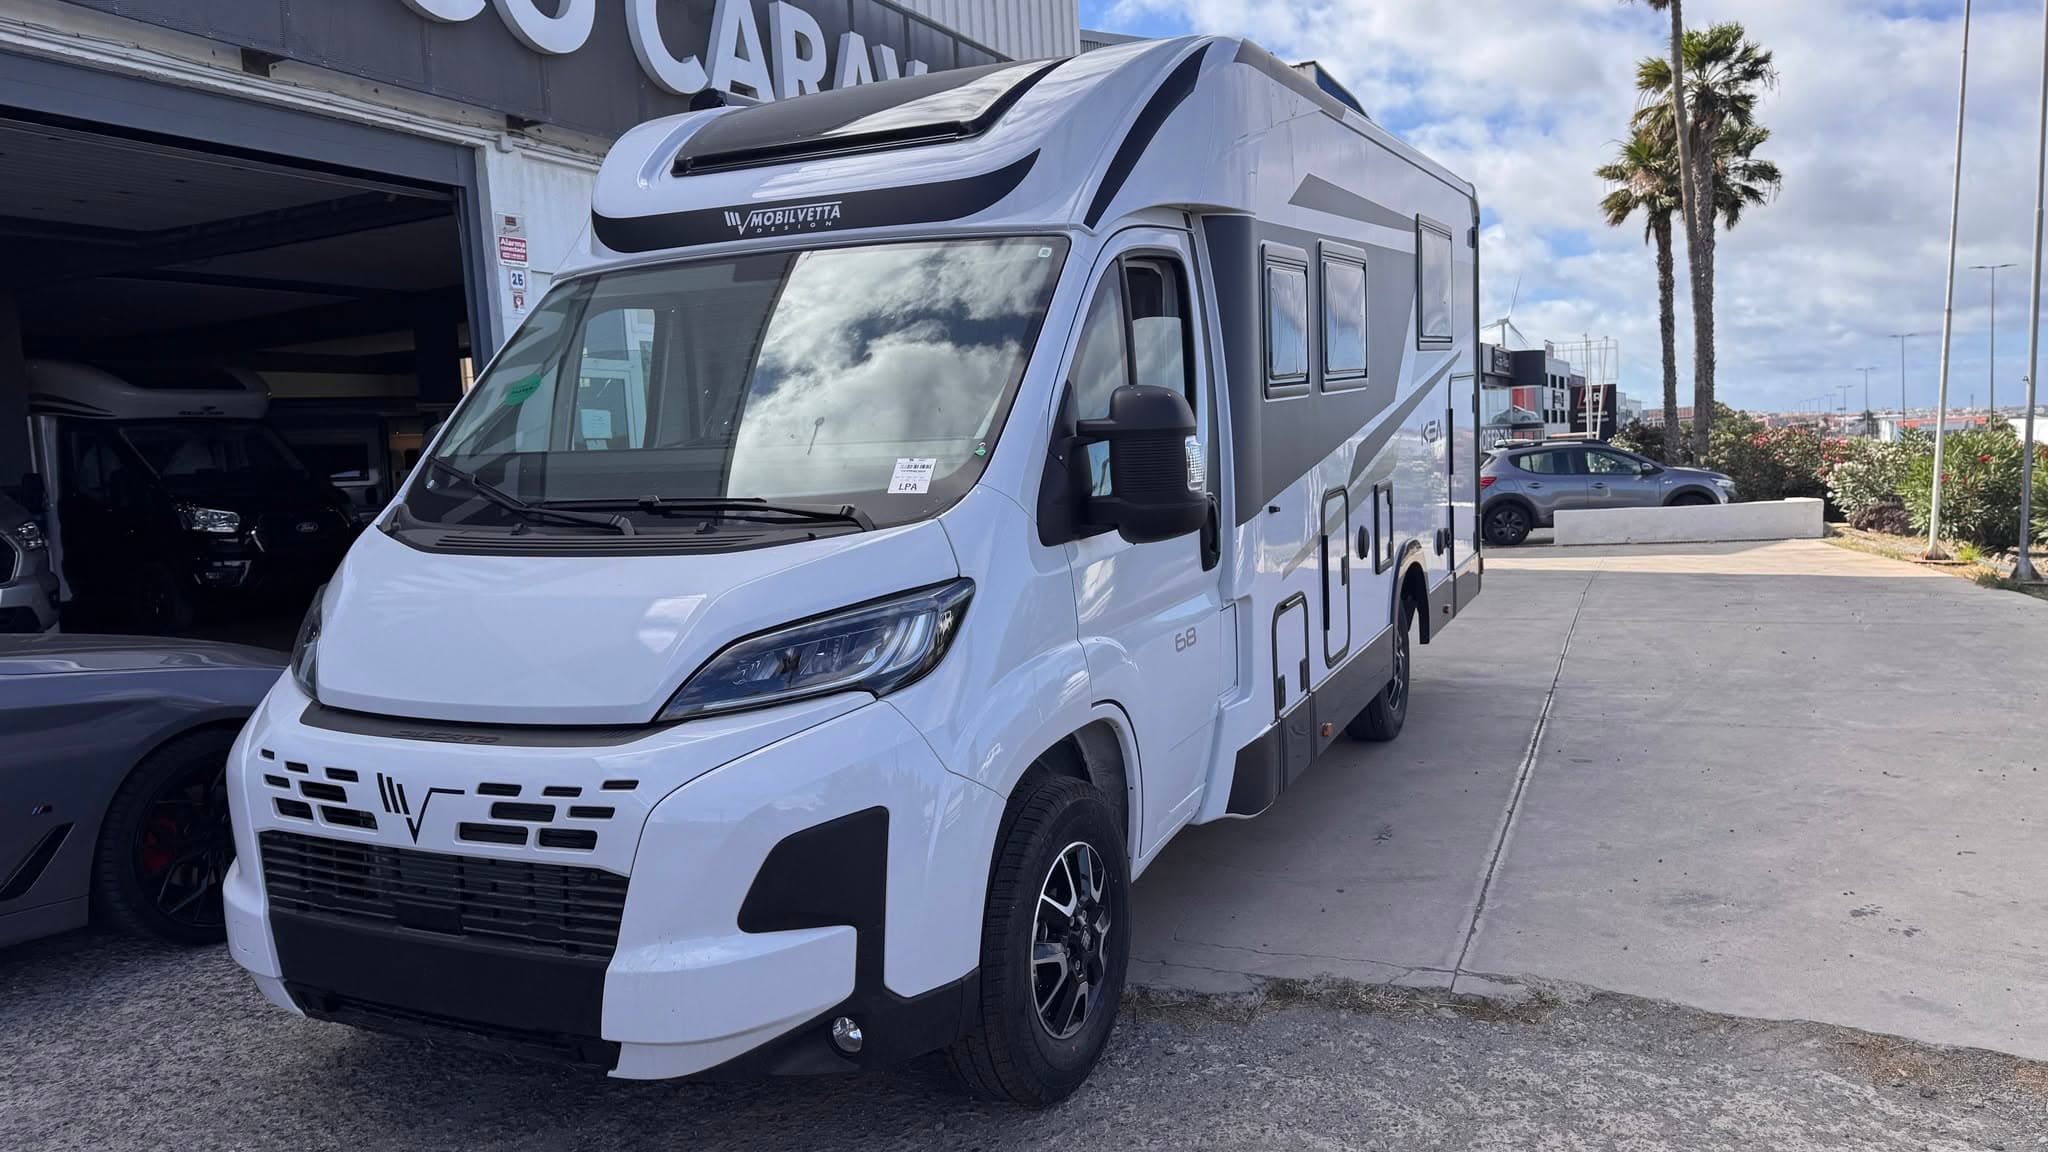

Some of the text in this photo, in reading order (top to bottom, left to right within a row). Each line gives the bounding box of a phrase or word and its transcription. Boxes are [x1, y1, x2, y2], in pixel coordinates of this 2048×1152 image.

[750, 204, 841, 228] MOBILVETTA
[756, 220, 832, 233] DESIGN
[500, 238, 526, 248] Alarma
[898, 482, 918, 491] LPA
[1174, 625, 1197, 652] 68
